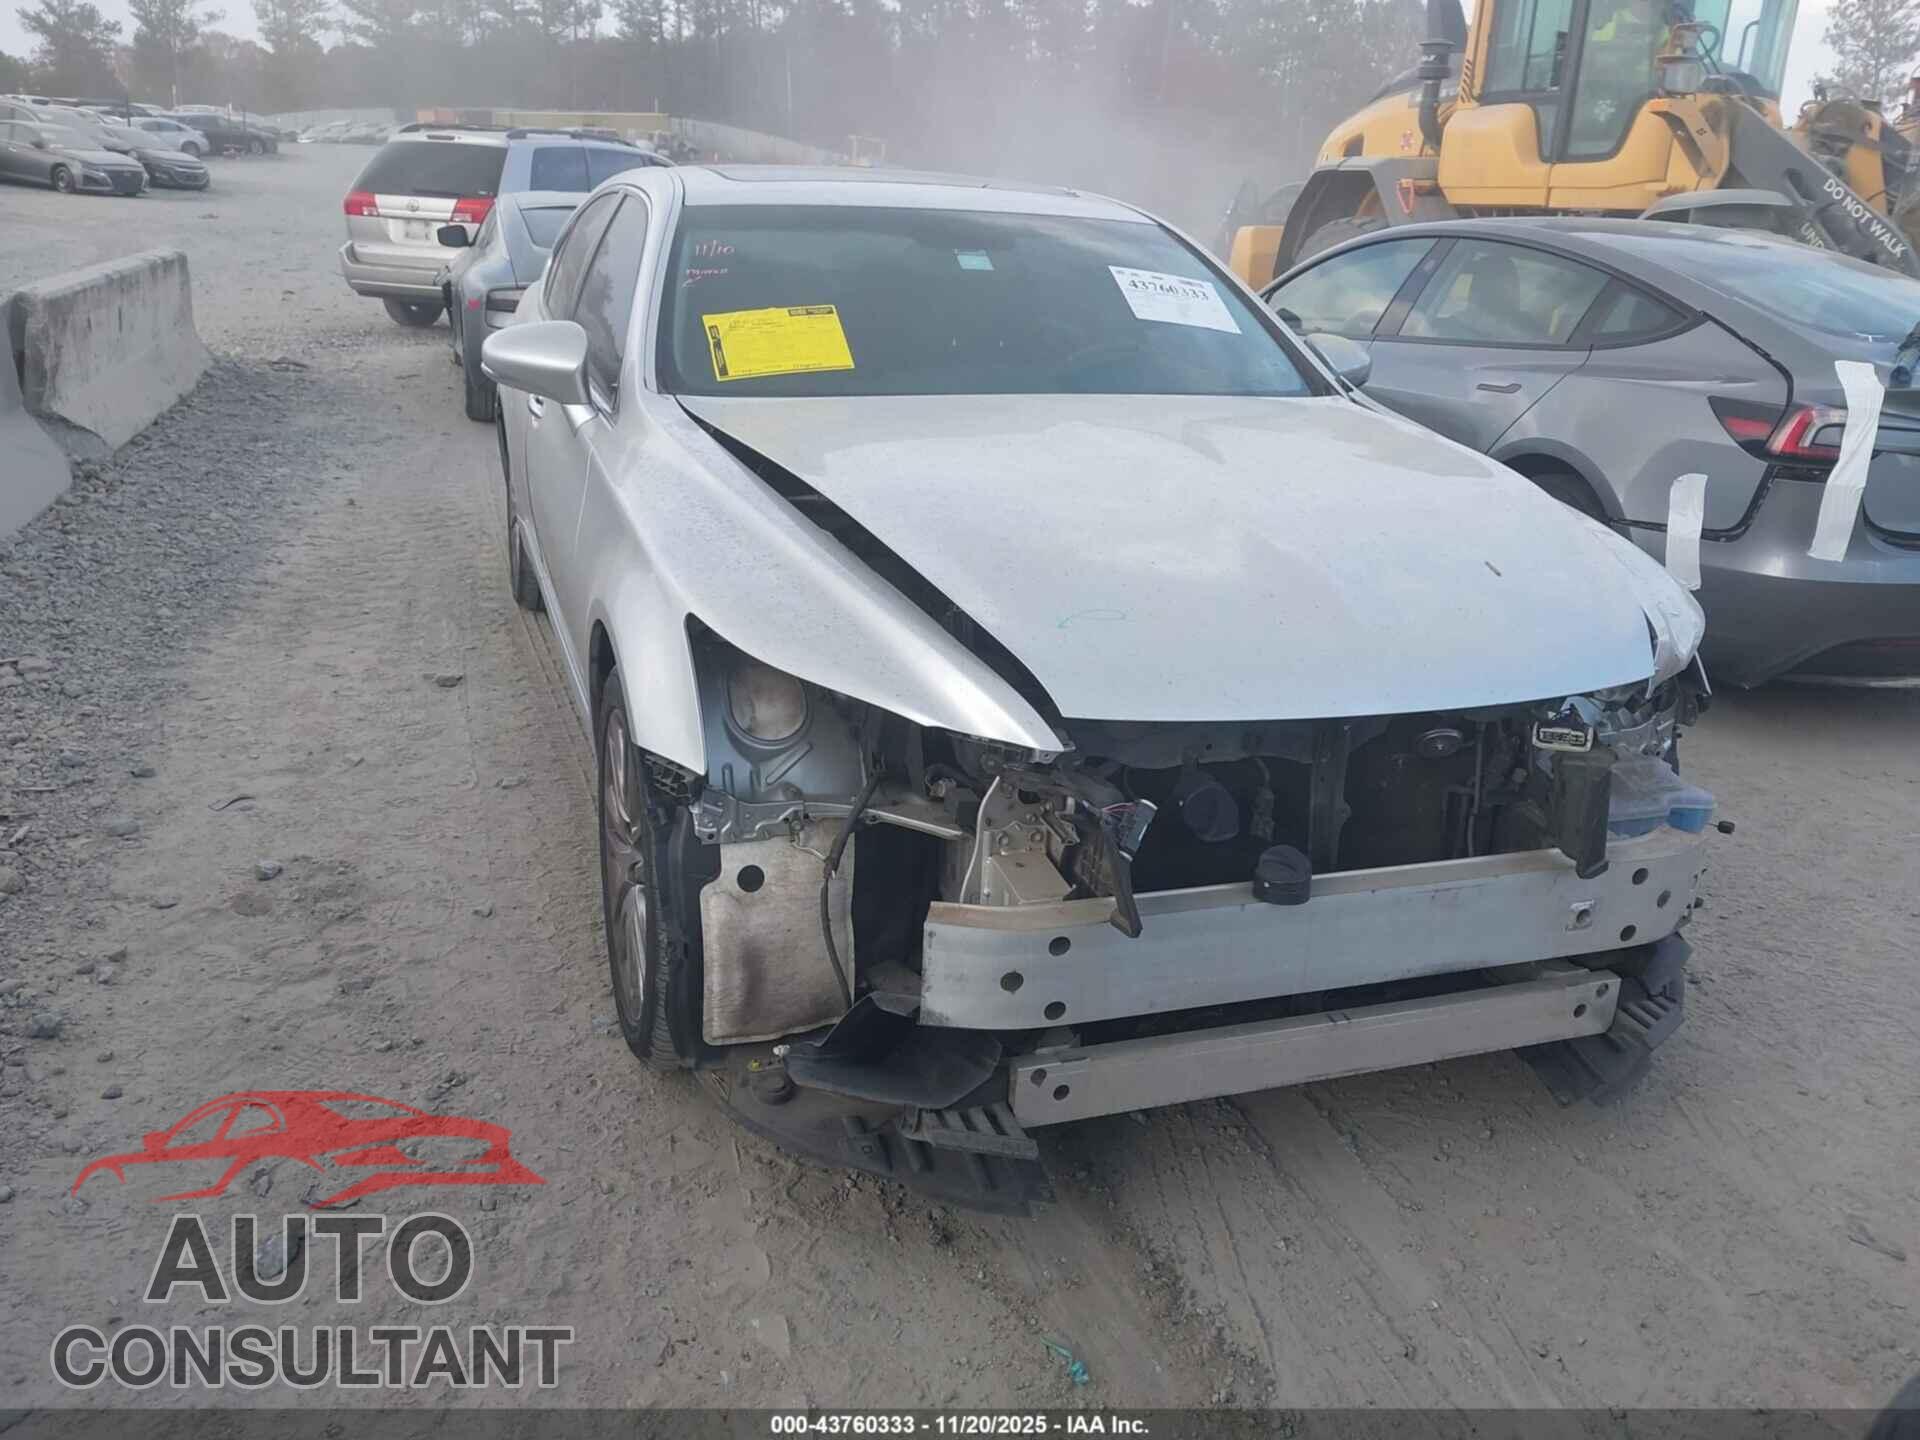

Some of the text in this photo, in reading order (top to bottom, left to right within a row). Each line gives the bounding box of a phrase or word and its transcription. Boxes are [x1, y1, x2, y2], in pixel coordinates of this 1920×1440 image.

[1823, 178, 1907, 258] DO NOT WALK
